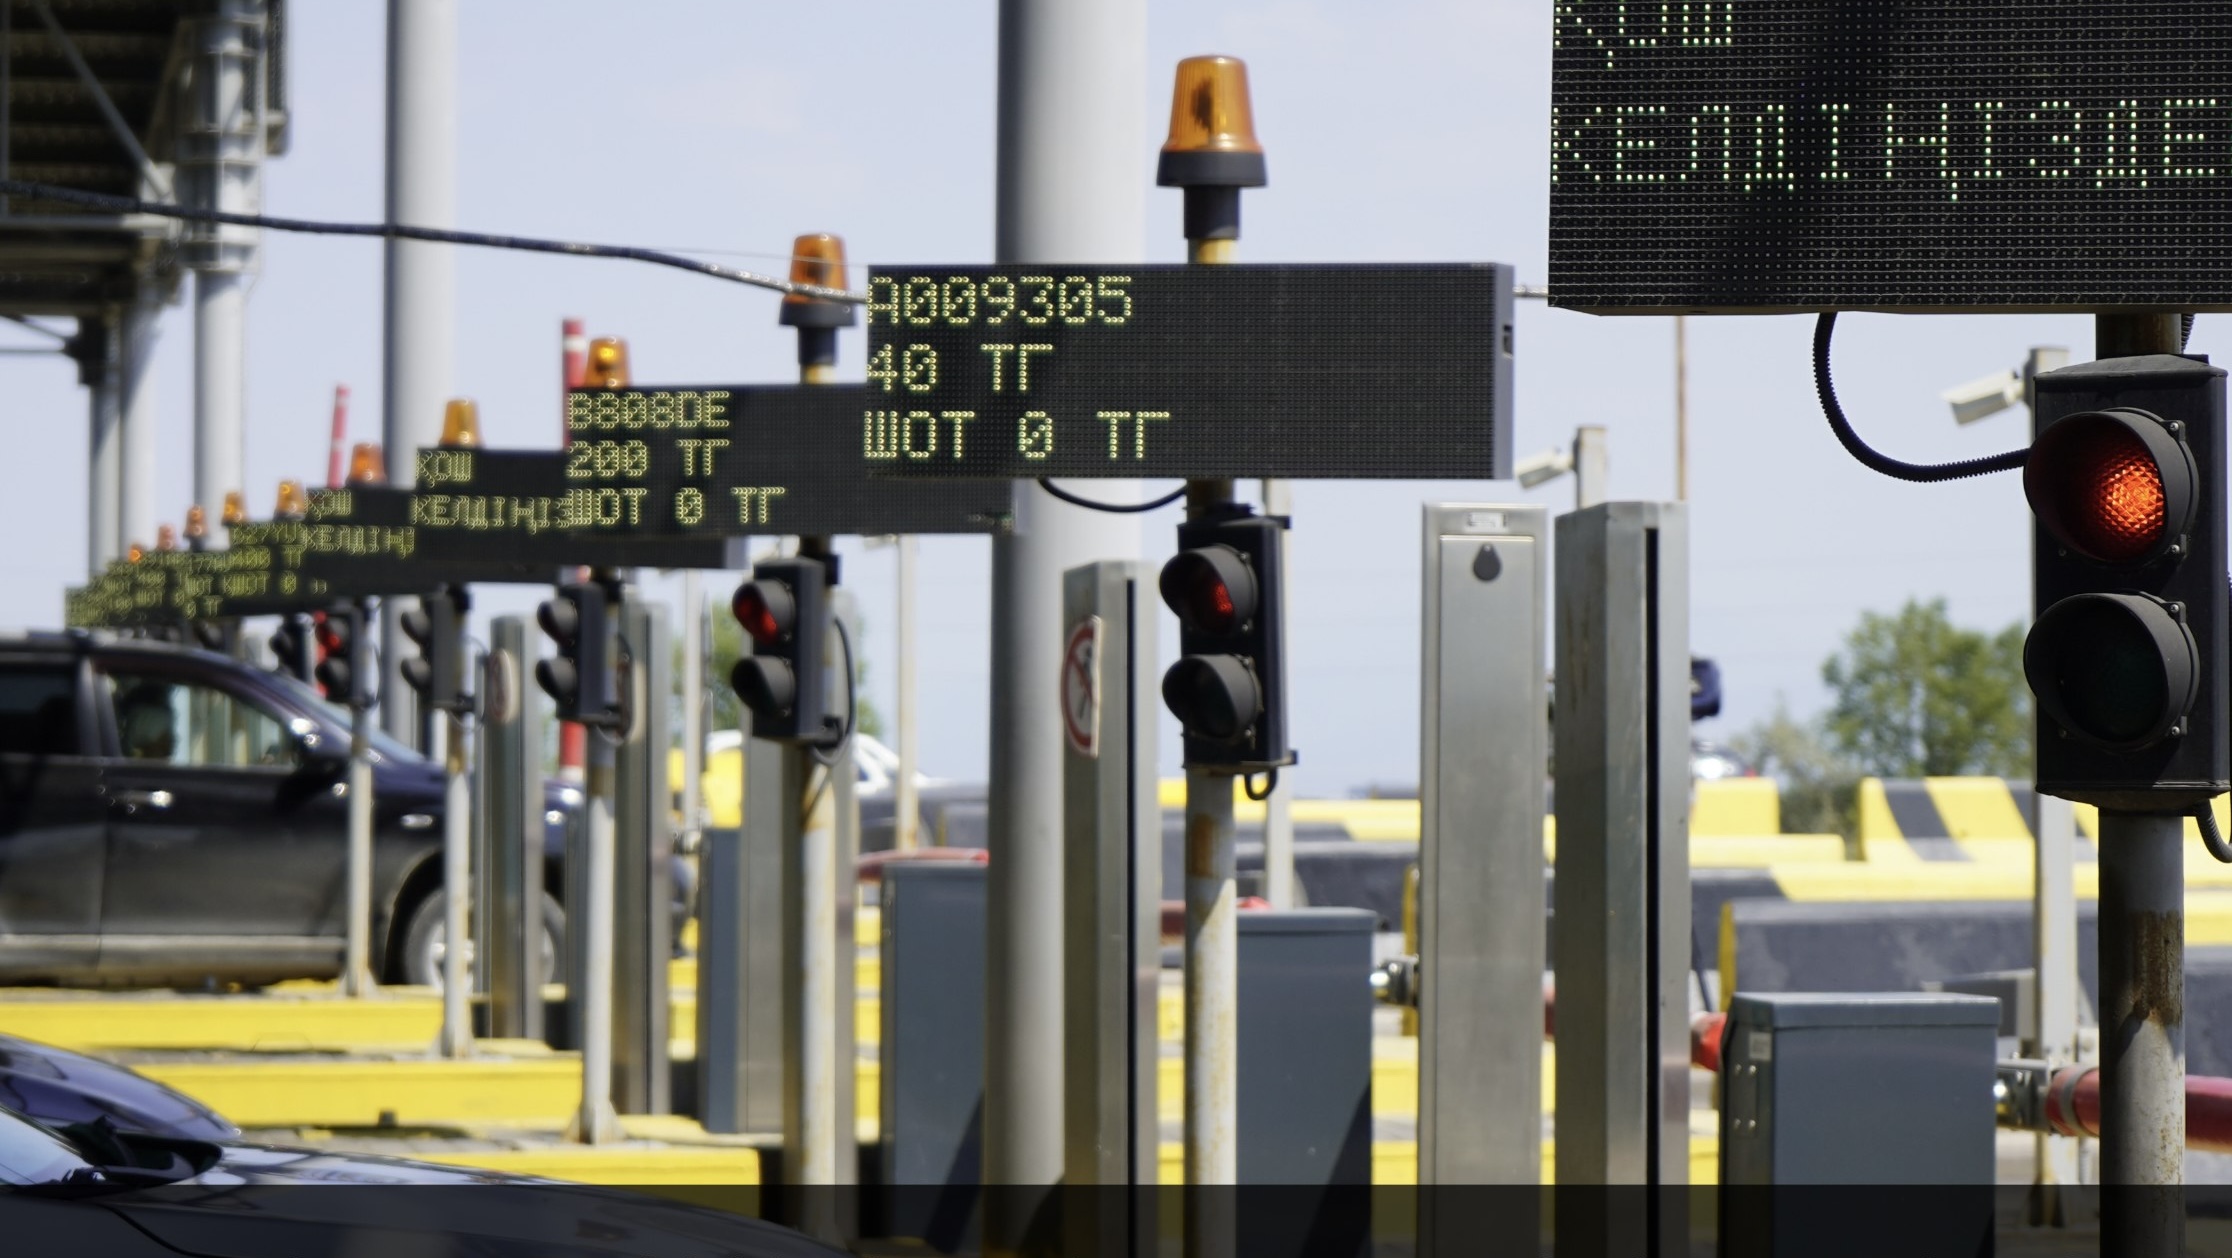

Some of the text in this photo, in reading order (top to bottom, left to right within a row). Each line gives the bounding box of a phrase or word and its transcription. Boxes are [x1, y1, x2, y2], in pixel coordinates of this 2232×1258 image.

[868, 275, 1132, 324] A009305
[866, 343, 937, 392] 40
[566, 440, 648, 477] 200
[864, 410, 975, 460] ШОТ
[1017, 410, 1055, 459] 0
